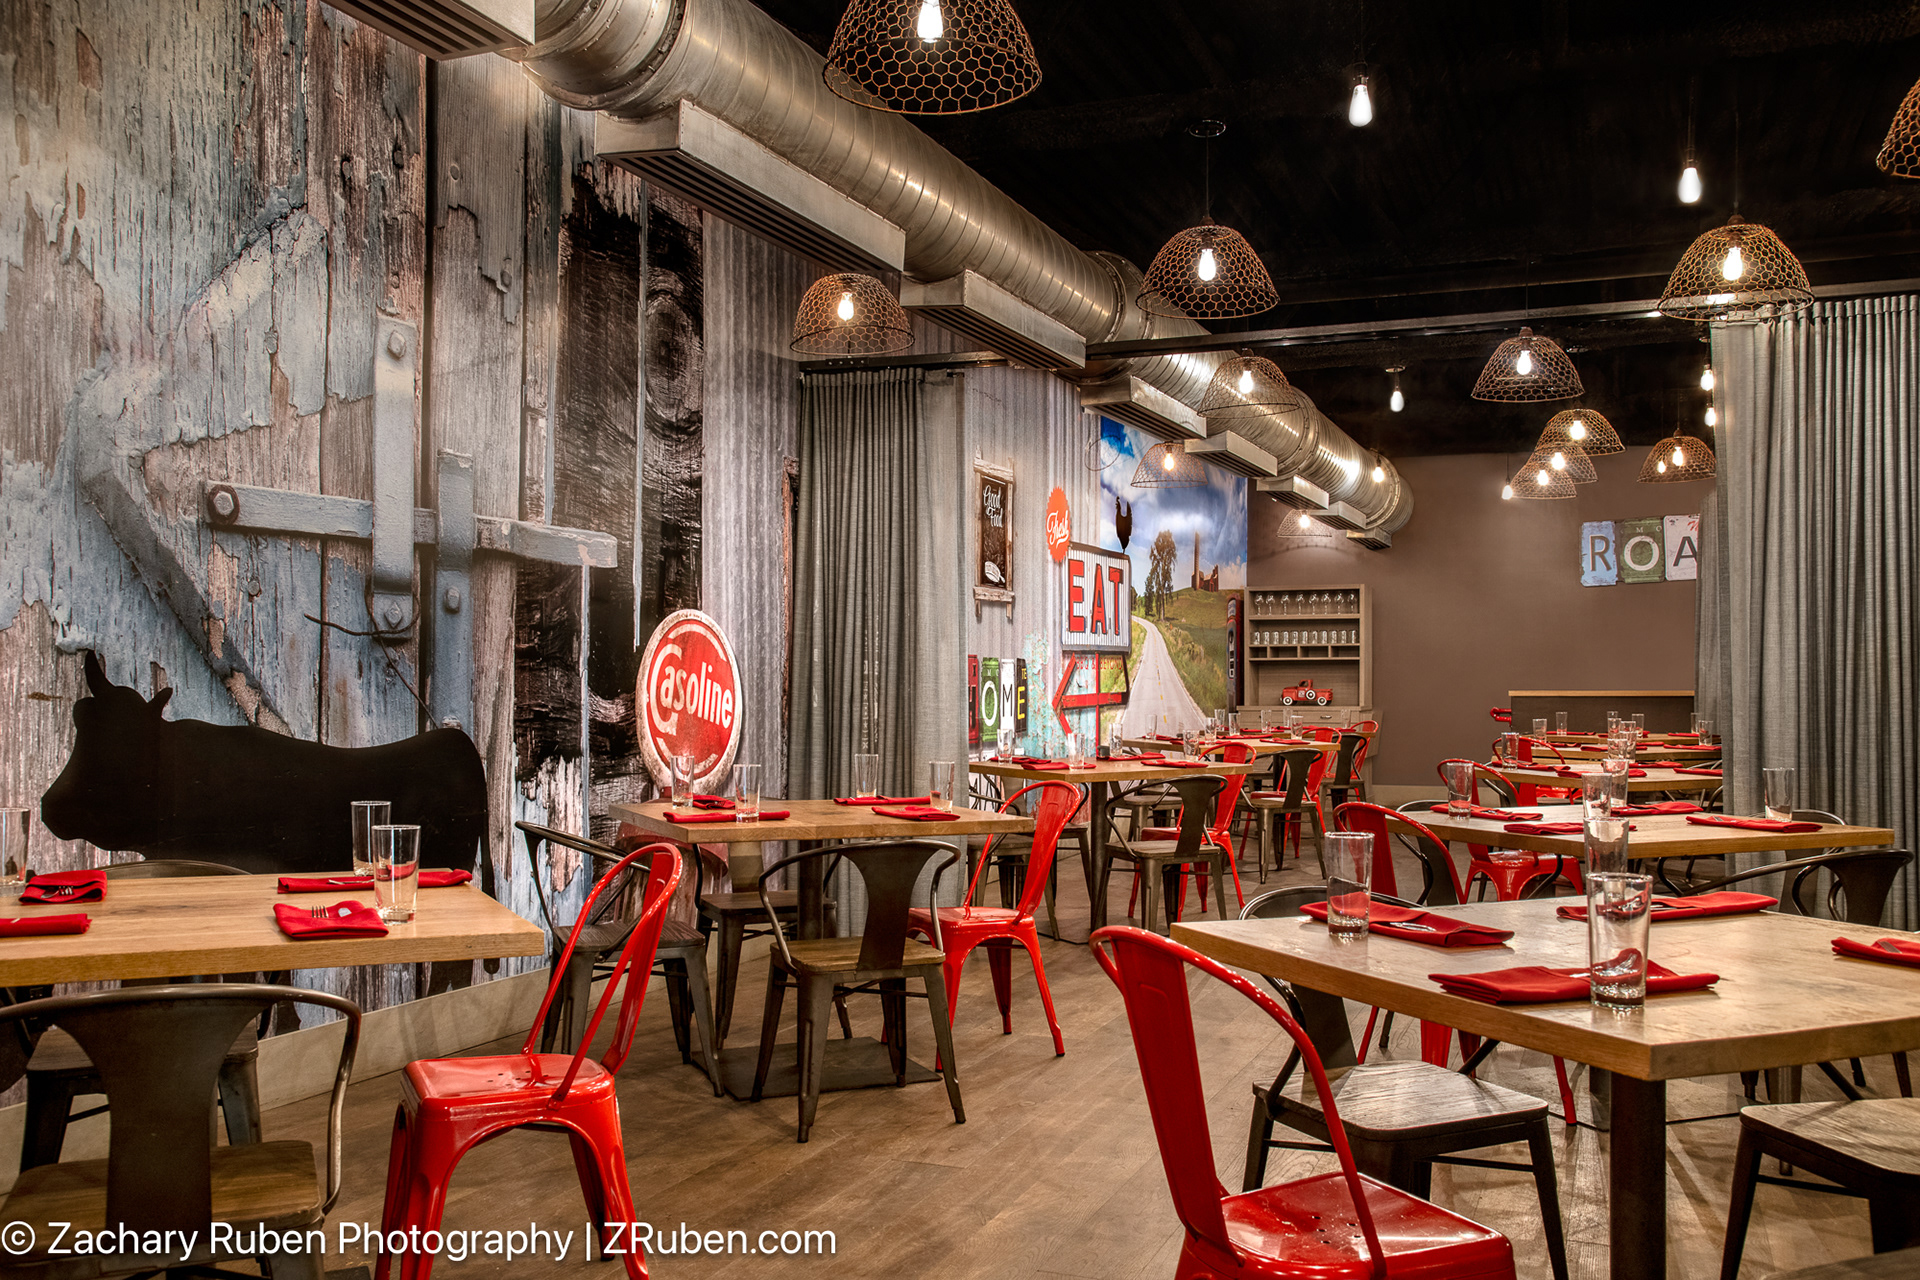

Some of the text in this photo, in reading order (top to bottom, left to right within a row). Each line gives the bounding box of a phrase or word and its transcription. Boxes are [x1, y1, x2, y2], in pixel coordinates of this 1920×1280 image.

[983, 484, 1001, 509] Good
[986, 507, 1004, 528] Food
[1046, 510, 1070, 548] Fresh
[1068, 558, 1124, 636] EAT
[1076, 656, 1089, 670] BBQ
[650, 643, 734, 736] Gasoline
